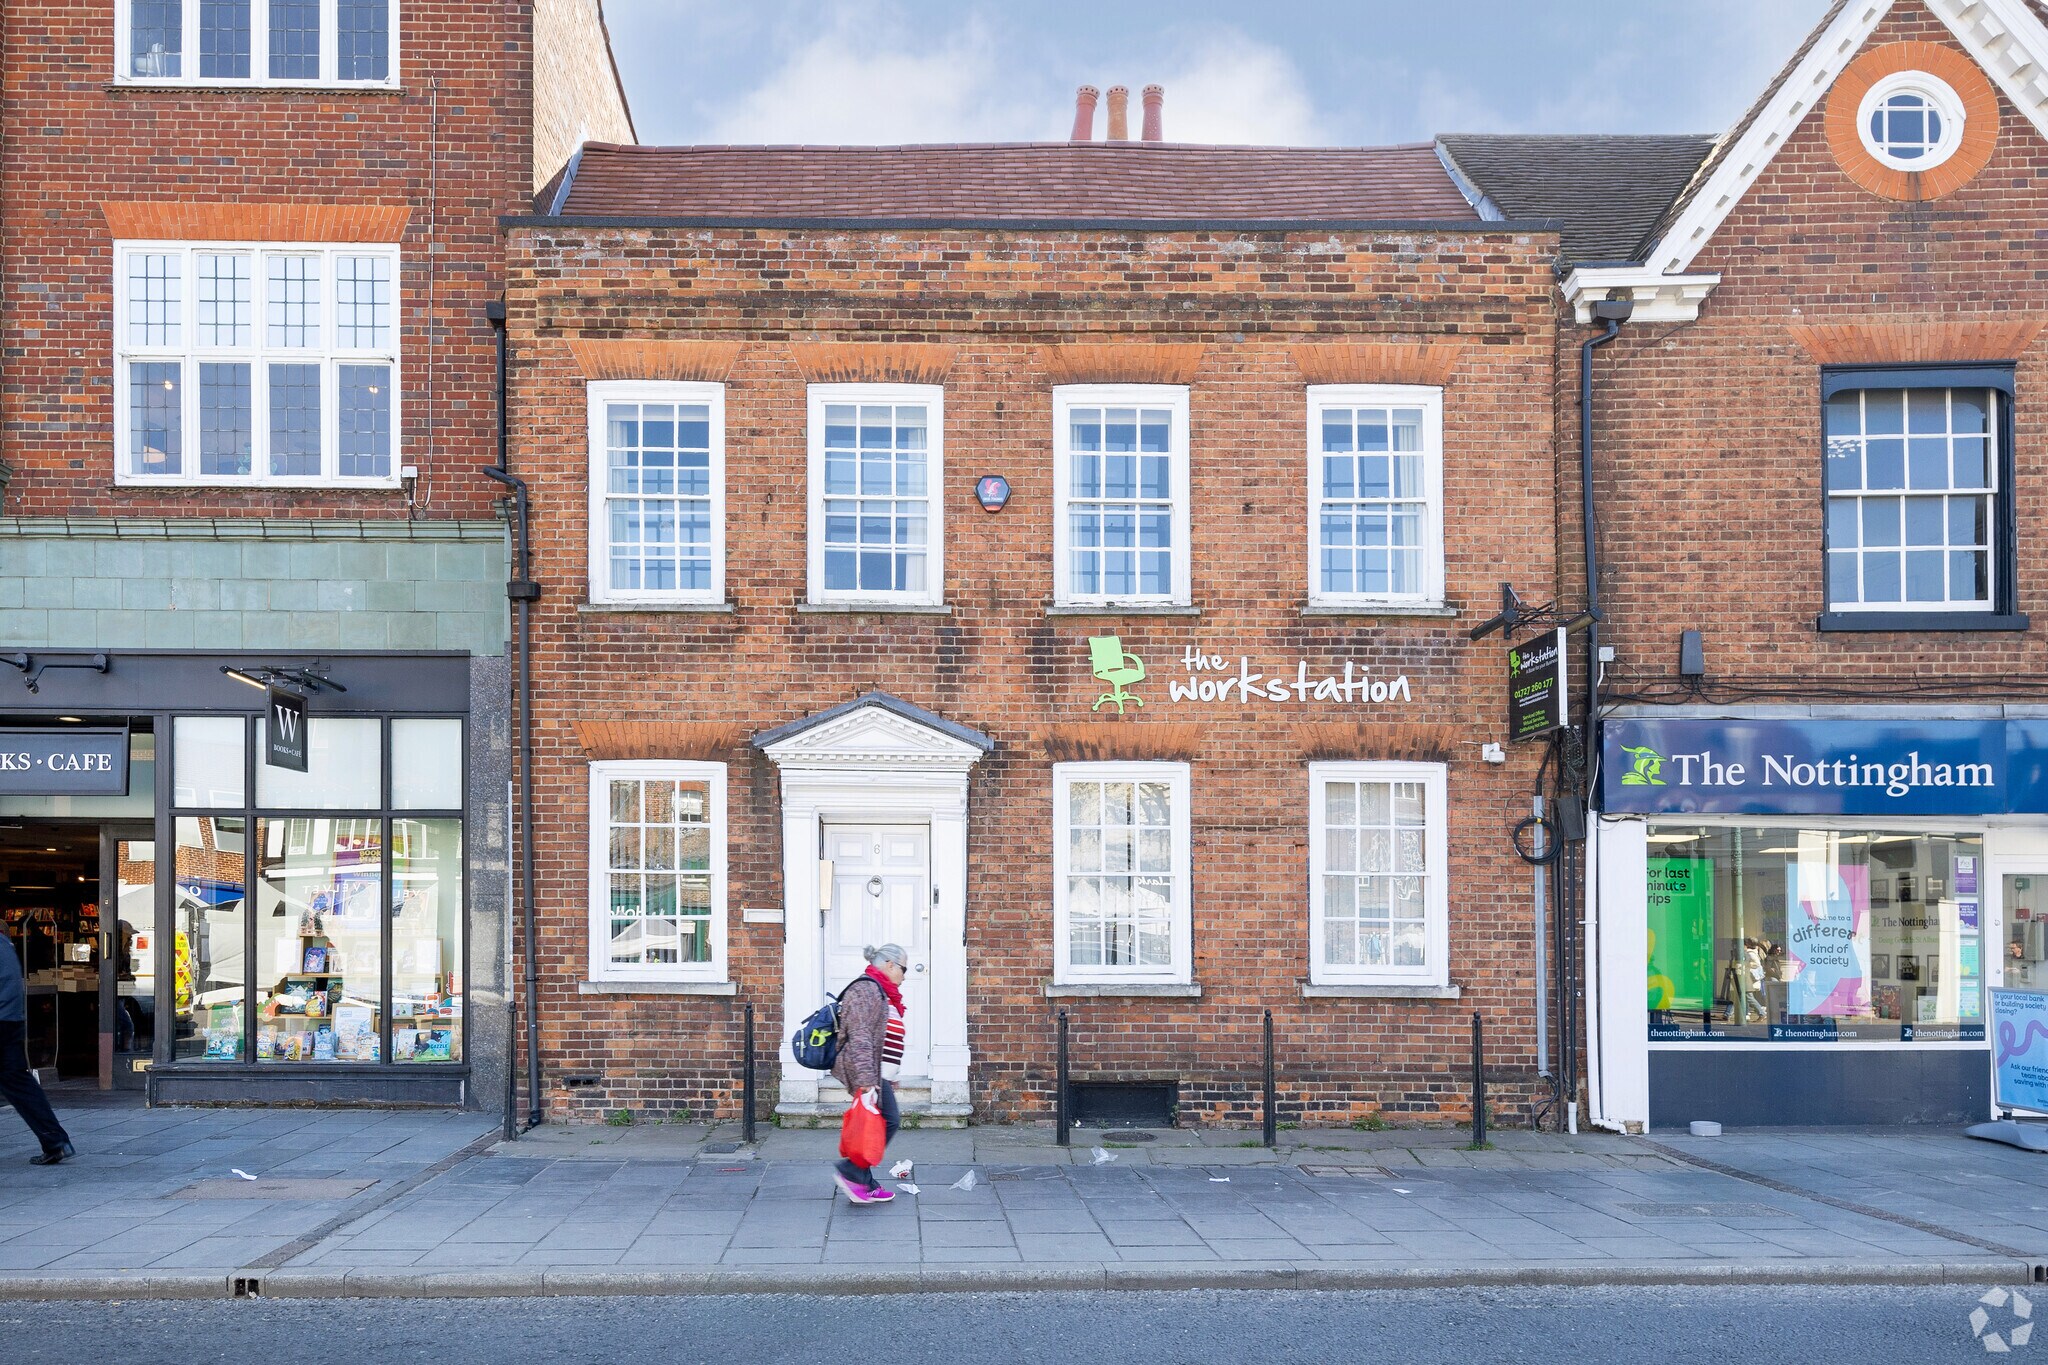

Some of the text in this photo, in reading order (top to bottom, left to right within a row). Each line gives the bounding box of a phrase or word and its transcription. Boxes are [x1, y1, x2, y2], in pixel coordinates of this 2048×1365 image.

[1181, 645, 1229, 671] the
[1520, 646, 1557, 670] workstation
[1169, 656, 1411, 703] workstation
[1514, 686, 1531, 698] 01727
[1531, 681, 1542, 692] 260
[1543, 677, 1553, 688] 177
[275, 704, 299, 742] W
[274, 744, 288, 754] BOOKS
[47, 753, 112, 771] CAFE
[1672, 751, 1995, 797] The Nottingham
[873, 843, 881, 855] 6
[1647, 867, 1690, 878] or last
[1647, 893, 1671, 906] rips
[1882, 915, 1939, 929] The Nottingha
[1793, 924, 1860, 943] differen
[1811, 944, 1849, 953] kind of
[1810, 955, 1849, 967] society
[1995, 1008, 2017, 1016] closing?
[2001, 1001, 2024, 1009] building
[2025, 1003, 2046, 1011] society
[1650, 1028, 1725, 1039] thenottingham.com
[1785, 1028, 1857, 1039] thenottingham.com
[1915, 1028, 1984, 1039] thenottingham.com
[2021, 1072, 2036, 1080] team
[2014, 1079, 2034, 1088] saving
